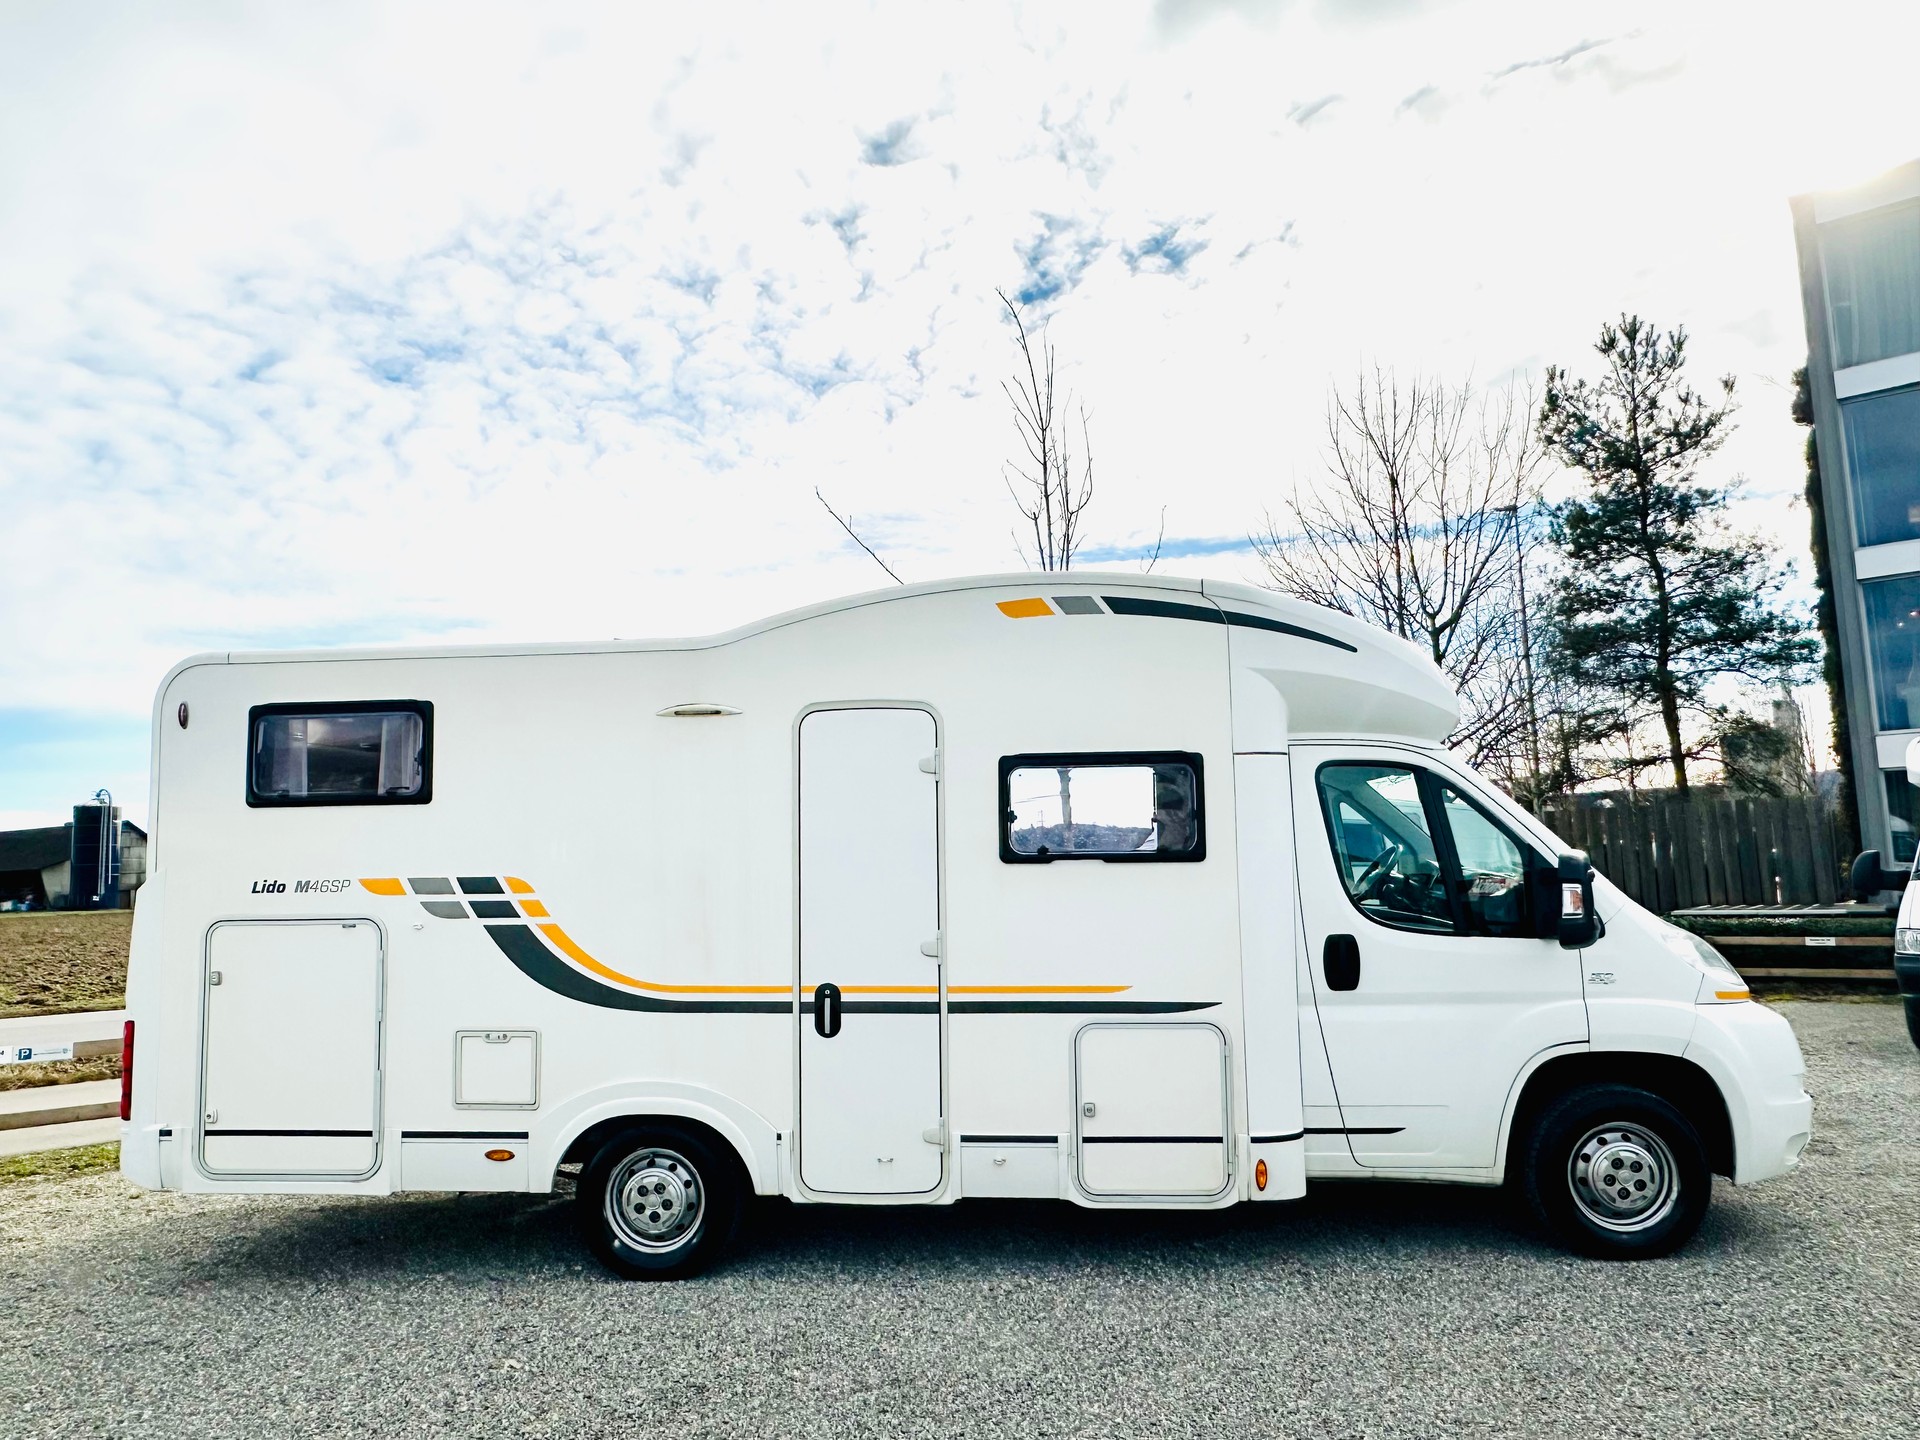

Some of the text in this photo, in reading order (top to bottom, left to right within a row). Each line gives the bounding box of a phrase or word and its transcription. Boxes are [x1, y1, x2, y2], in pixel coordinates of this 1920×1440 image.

[251, 879, 351, 893] Lido M46SP
[21, 1049, 30, 1059] P
